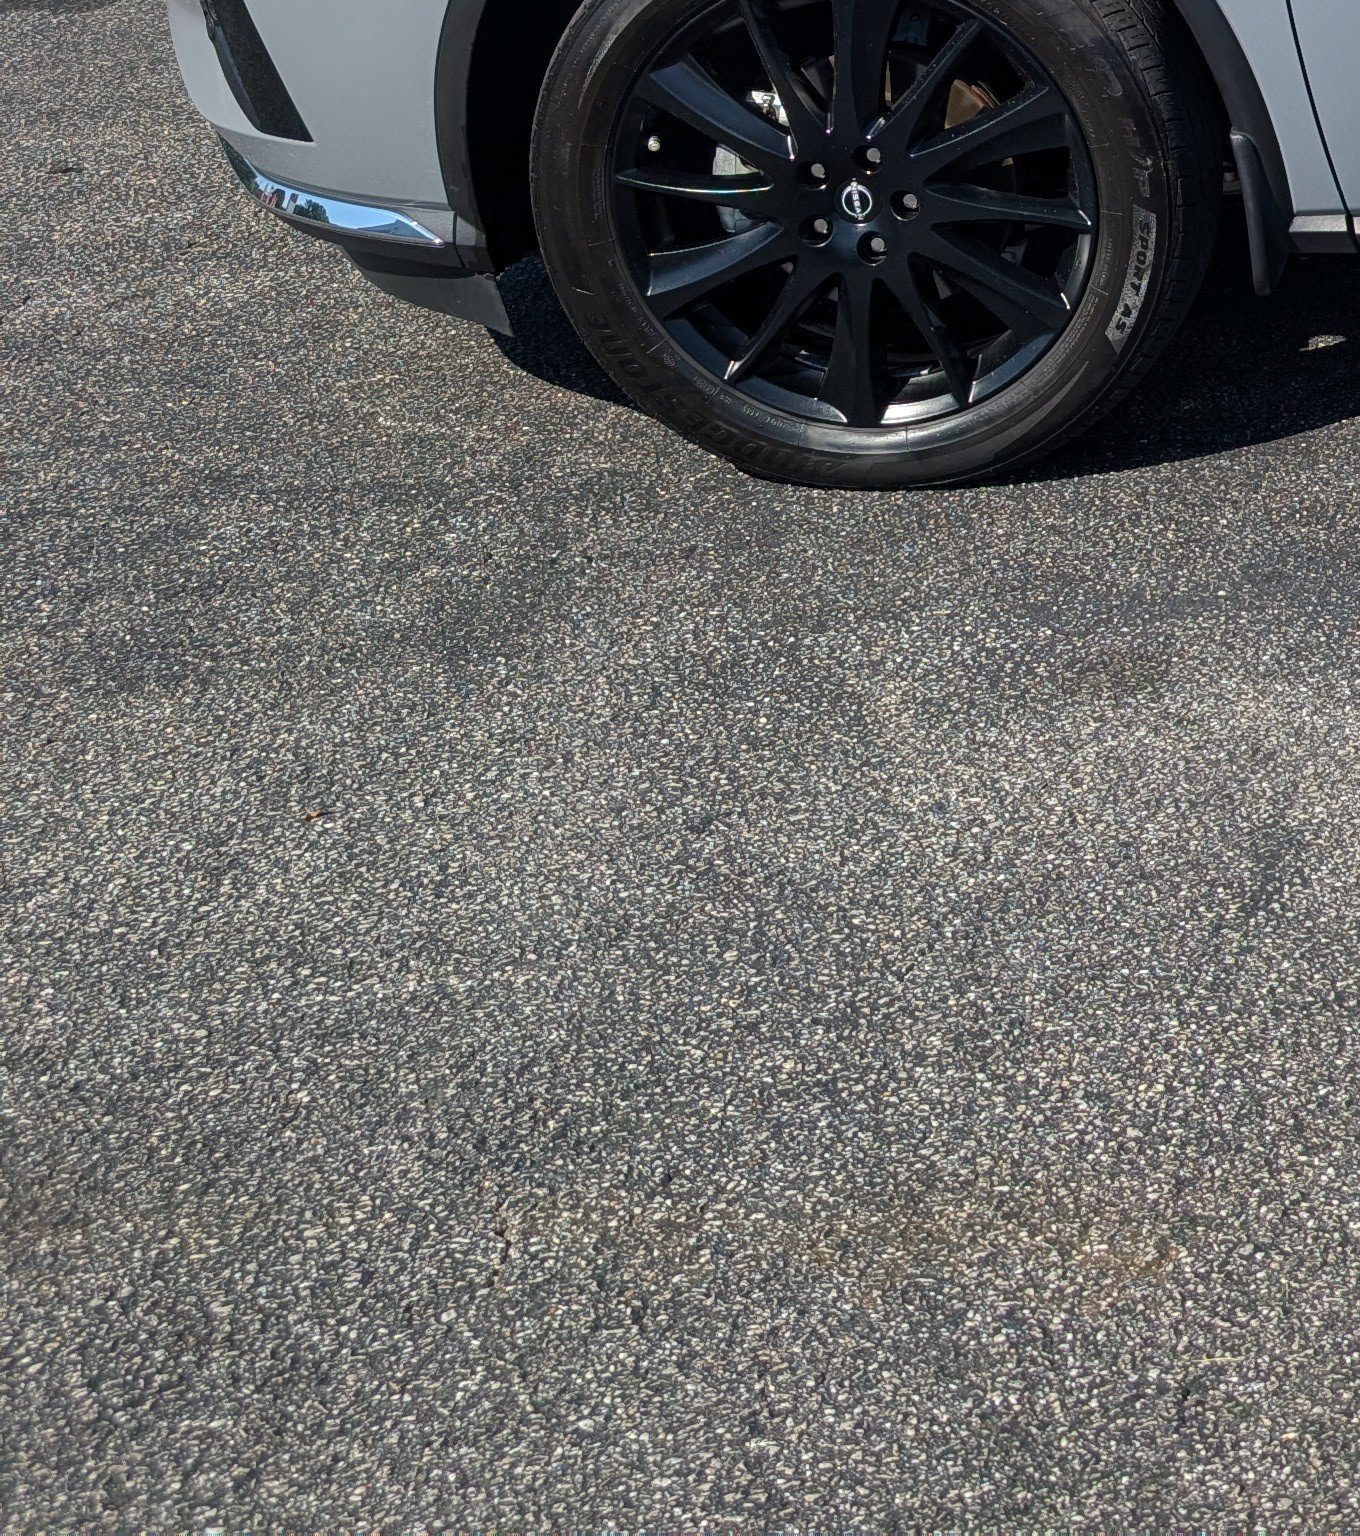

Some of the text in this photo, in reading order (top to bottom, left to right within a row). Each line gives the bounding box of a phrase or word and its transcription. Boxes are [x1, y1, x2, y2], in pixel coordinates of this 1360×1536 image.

[850, 181, 864, 220] NISSAN
[1127, 220, 1152, 298] SPORT
[1113, 301, 1135, 335] AS
